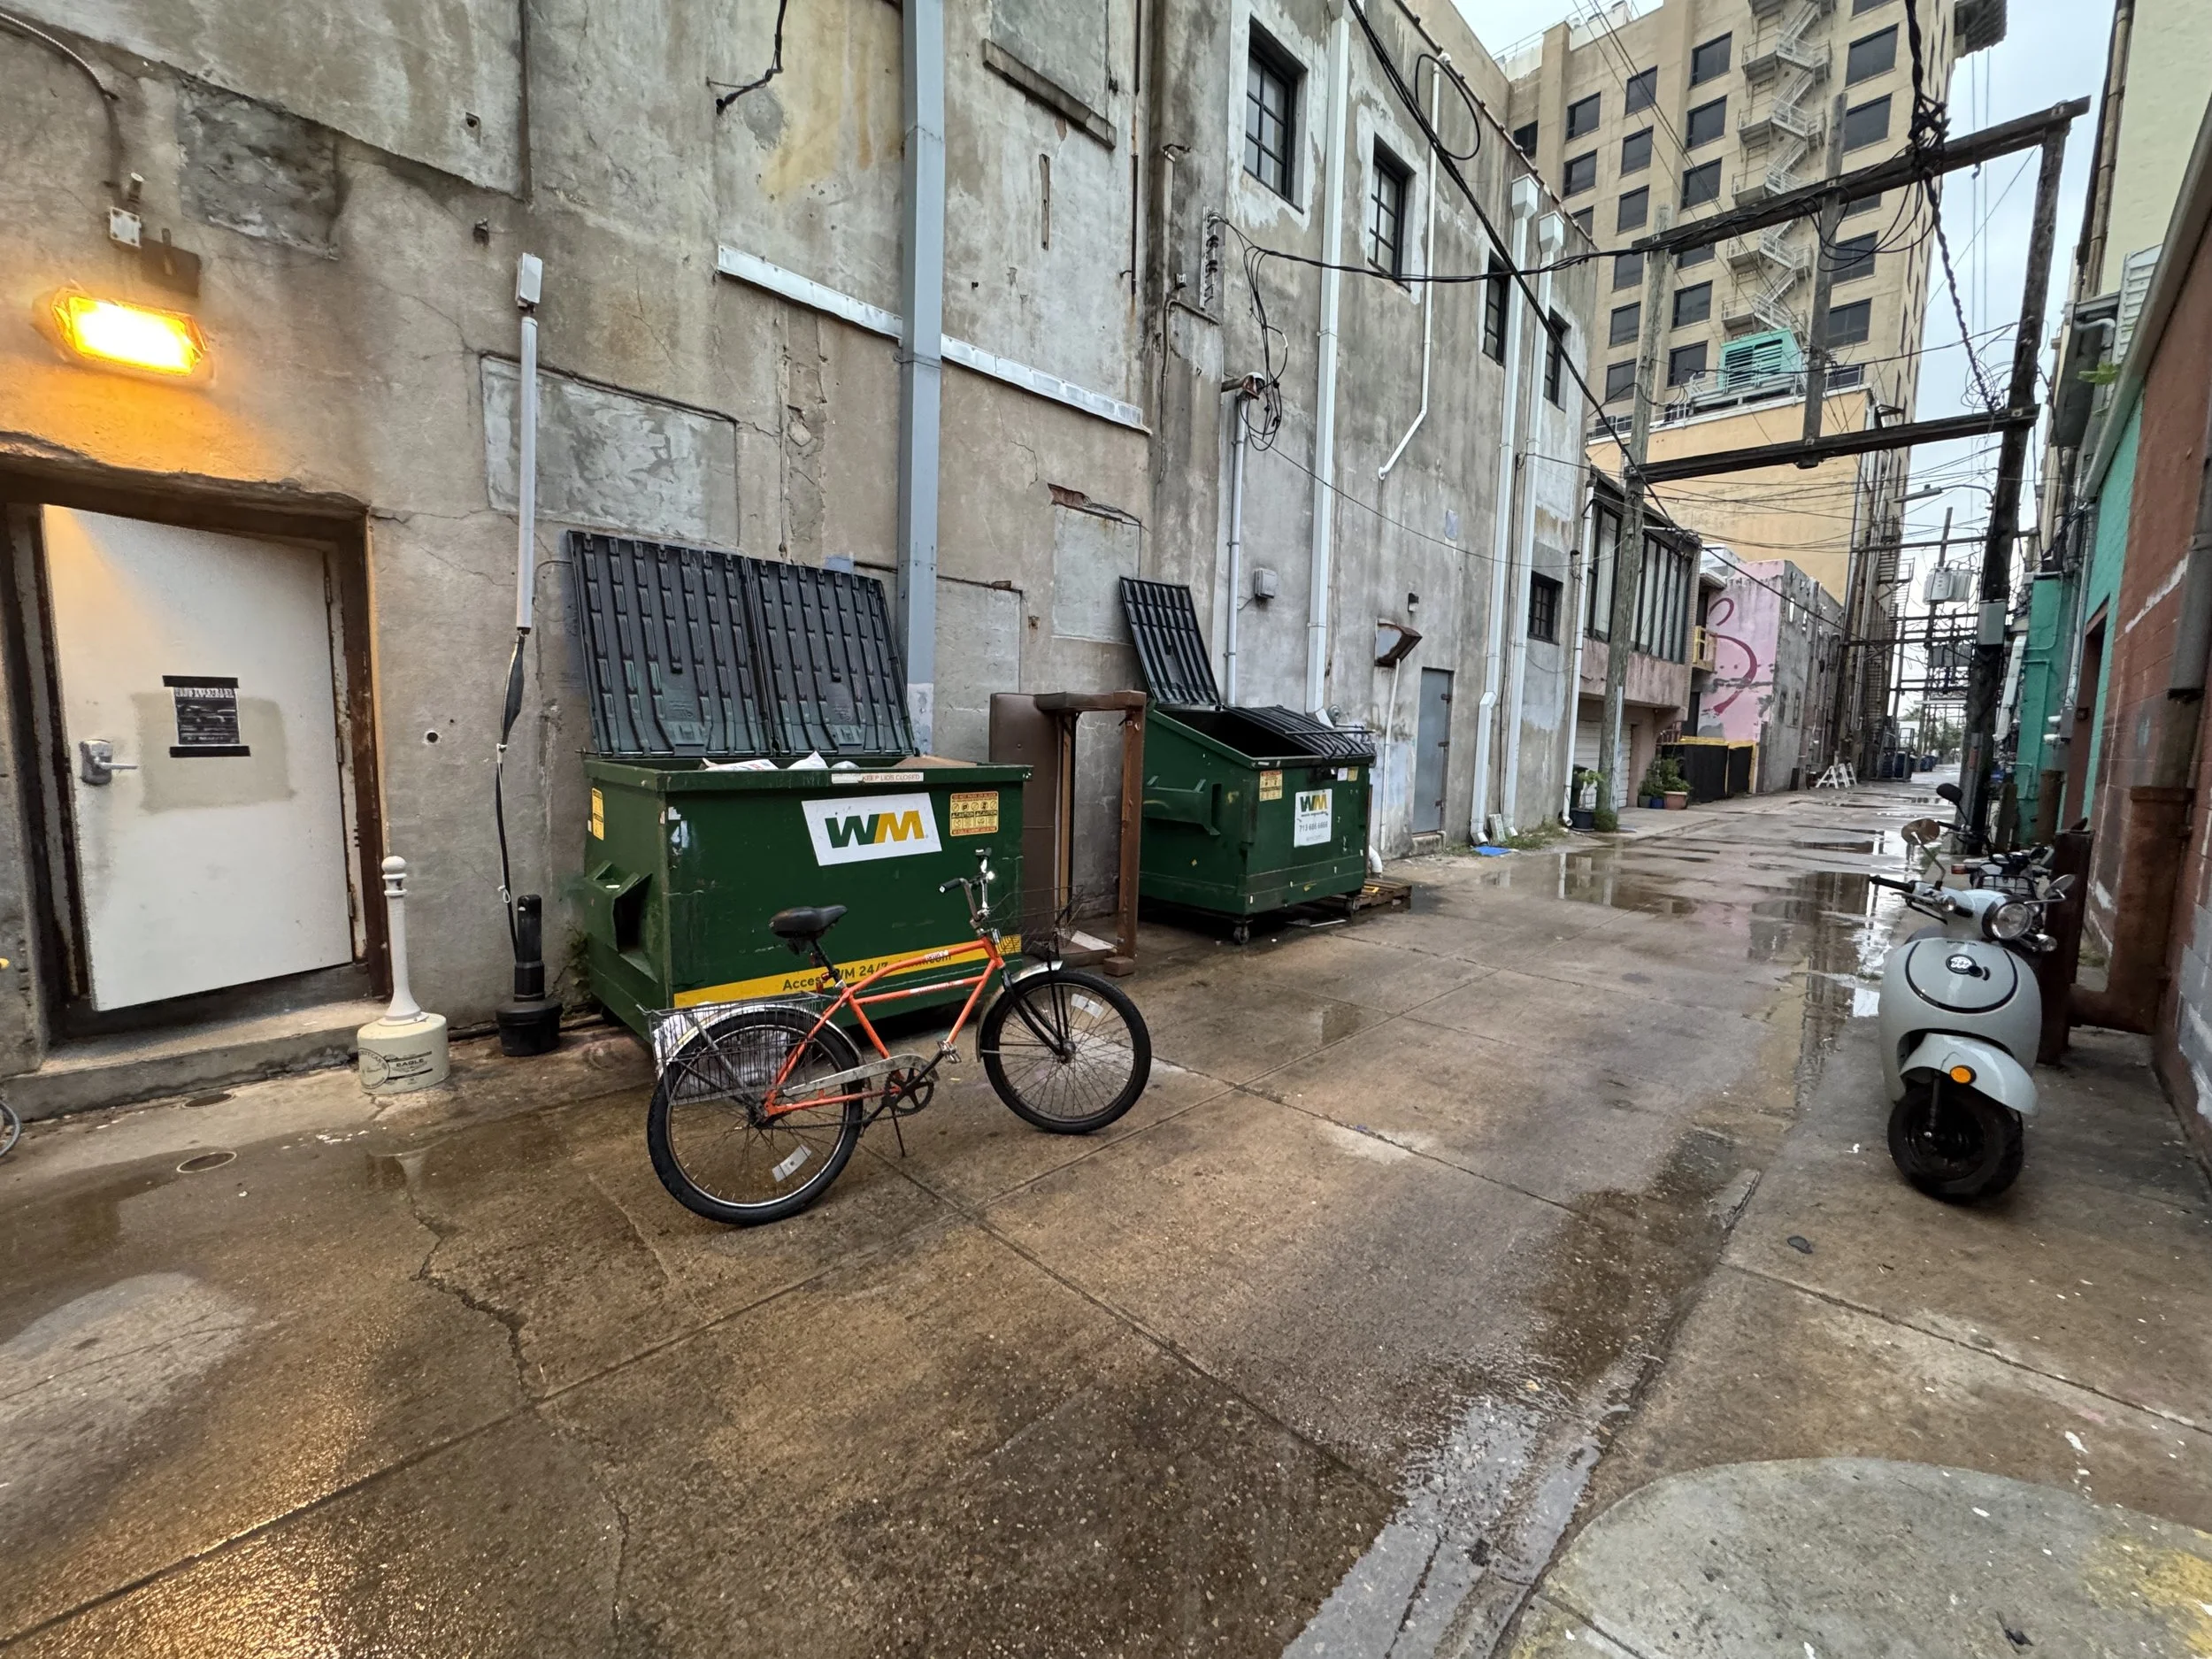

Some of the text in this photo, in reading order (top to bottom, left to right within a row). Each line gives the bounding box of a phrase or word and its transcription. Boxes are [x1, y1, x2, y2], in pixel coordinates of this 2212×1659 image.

[1300, 794, 1327, 812] WM
[825, 810, 926, 849] WM
[783, 976, 825, 991] Acces
[396, 1058, 424, 1067] EAGLE
